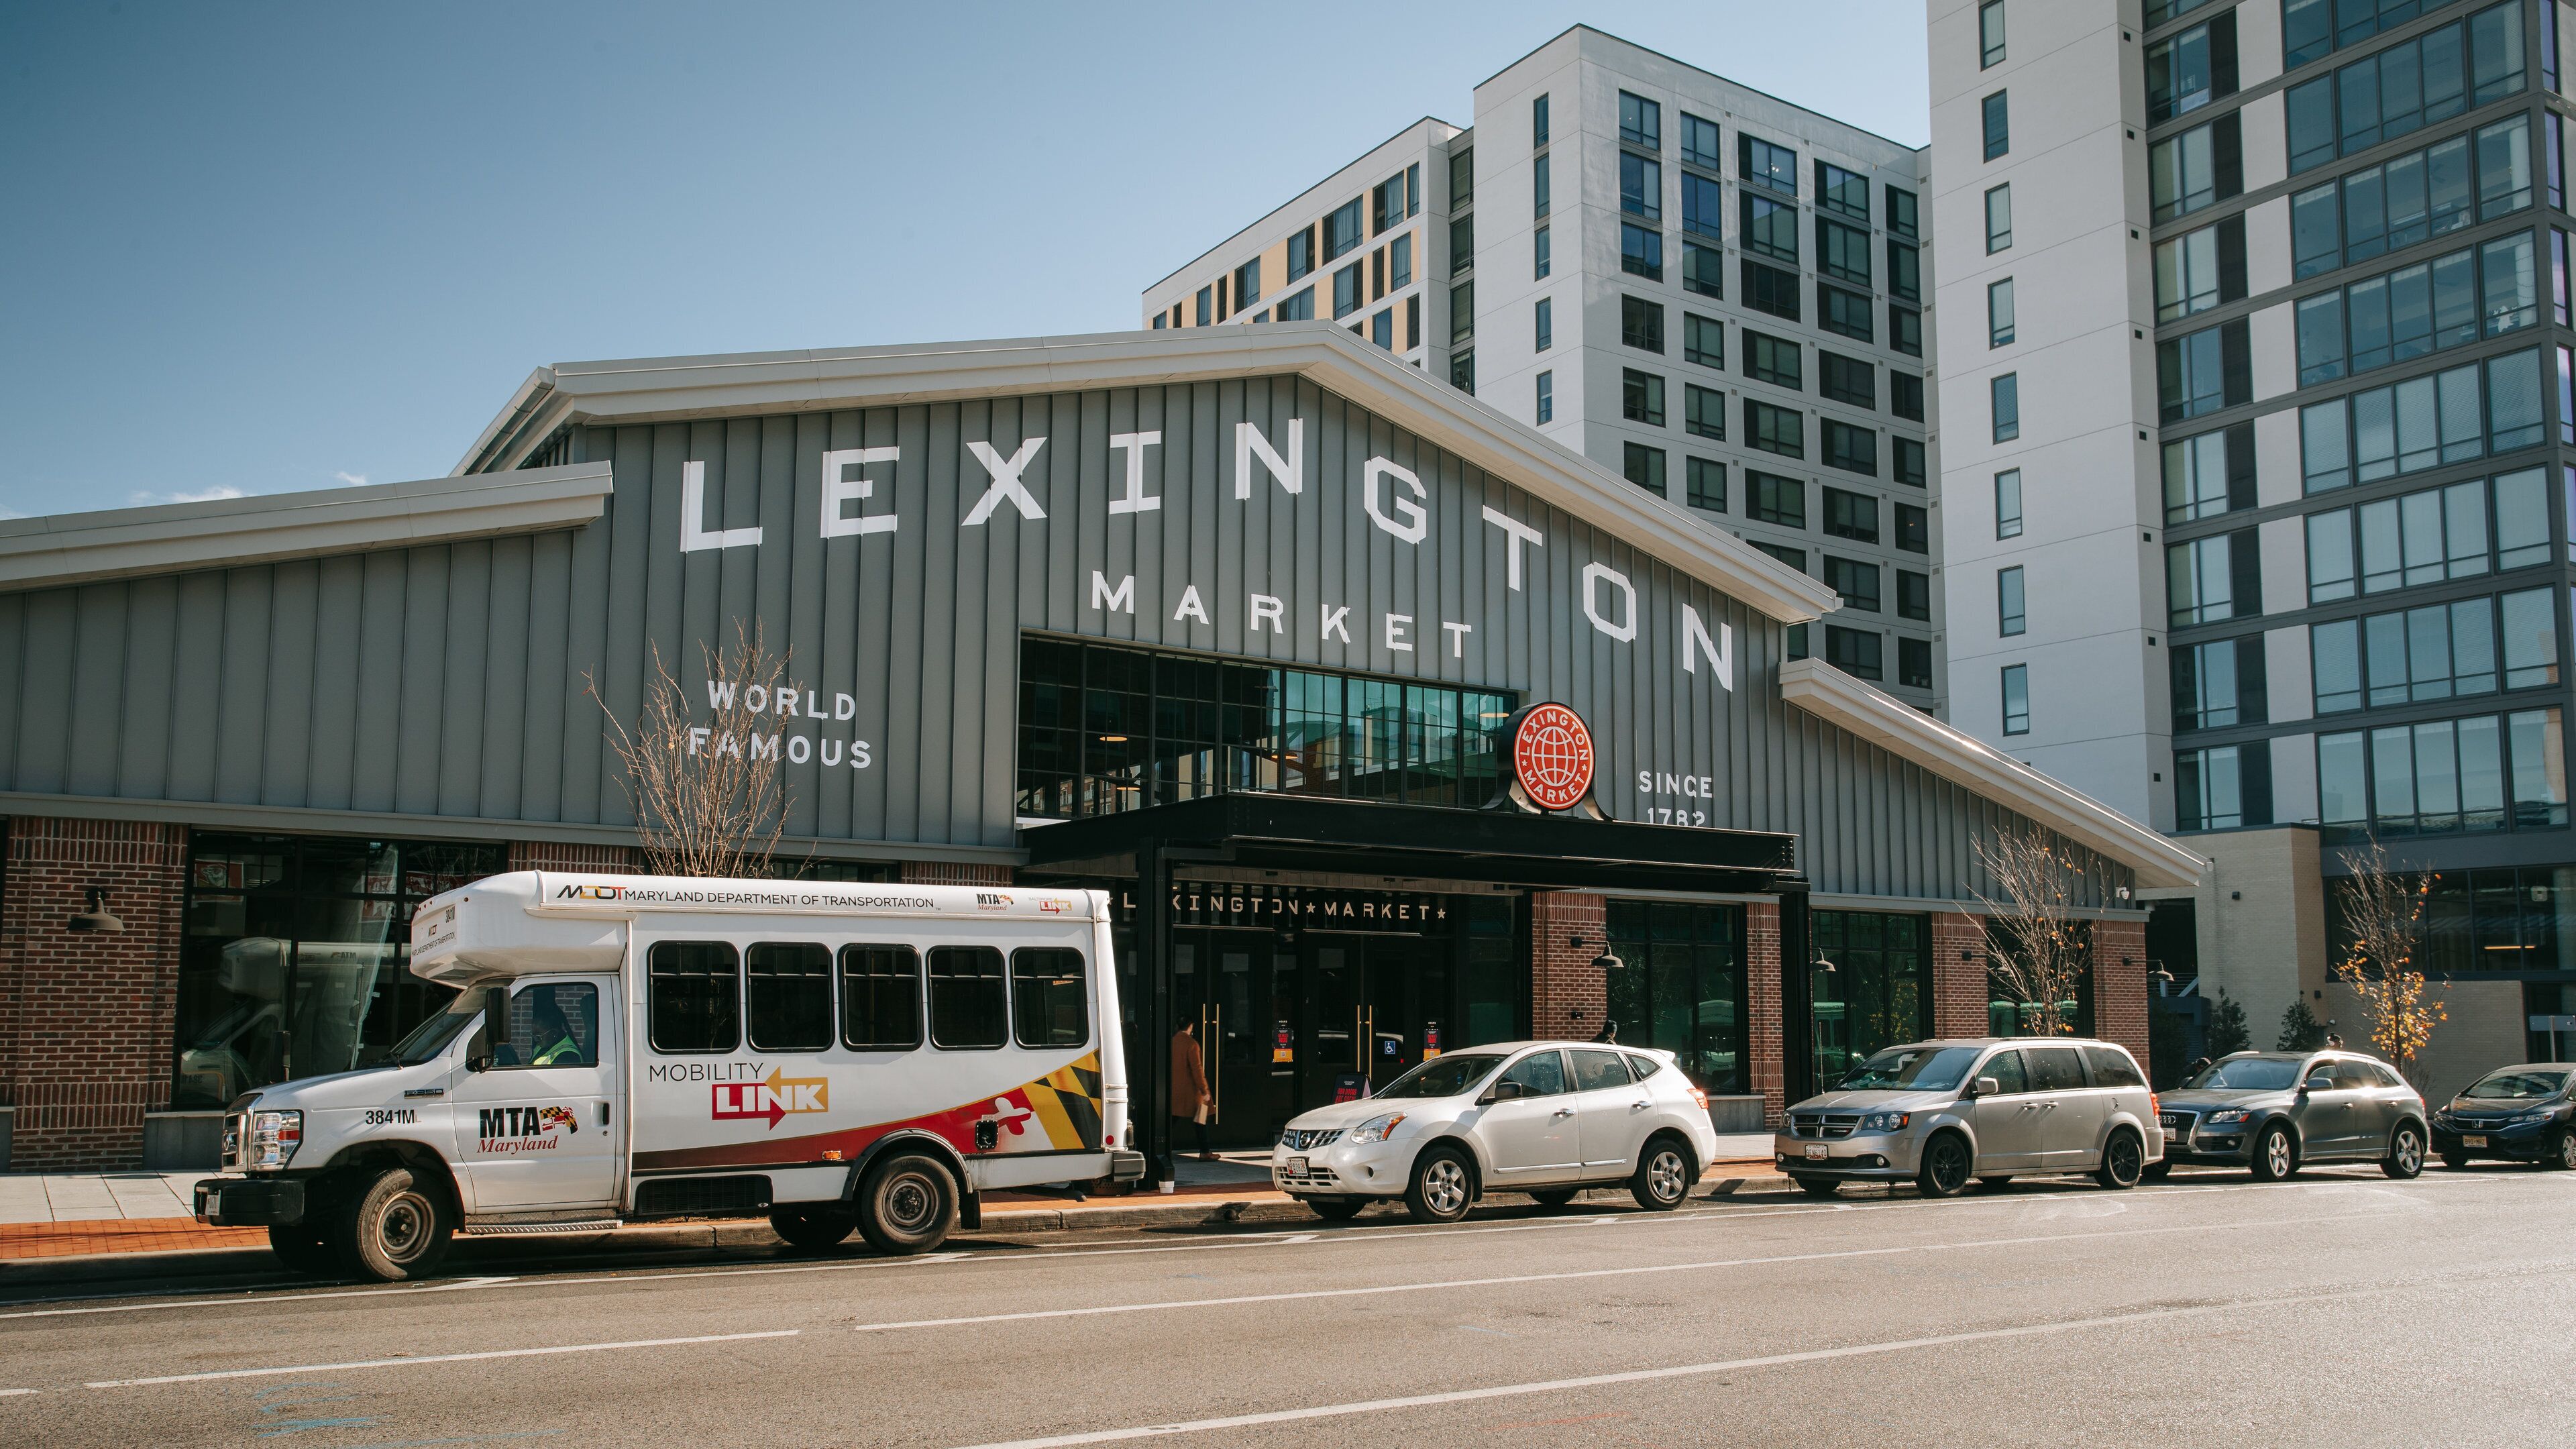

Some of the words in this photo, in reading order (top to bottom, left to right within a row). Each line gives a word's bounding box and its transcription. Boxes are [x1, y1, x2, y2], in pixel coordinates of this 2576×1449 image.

[680, 419, 1733, 692] LEXINGTON
[1091, 571, 1472, 658] MARKET
[708, 680, 857, 721] WORLD
[690, 727, 872, 769] FAMOUS
[1520, 711, 1589, 761] LEXINGTON
[1525, 769, 1585, 802] MARKET
[1639, 771, 1713, 798] SINCE
[1648, 807, 1705, 826] 1782
[557, 885, 627, 900] MDOT
[626, 890, 704, 902] MARYLAND
[708, 892, 798, 905] DEPARTMENT
[801, 895, 819, 905] OF
[822, 896, 934, 908] TRANSPORTATION
[977, 894, 1000, 905] MTA
[1040, 901, 1071, 910] LINK
[1324, 902, 1430, 920] MARKET
[649, 1063, 764, 1082] MOBILITY
[716, 1085, 823, 1112] LINK
[480, 1106, 542, 1138] MTA
[477, 1135, 558, 1155] Maryland
